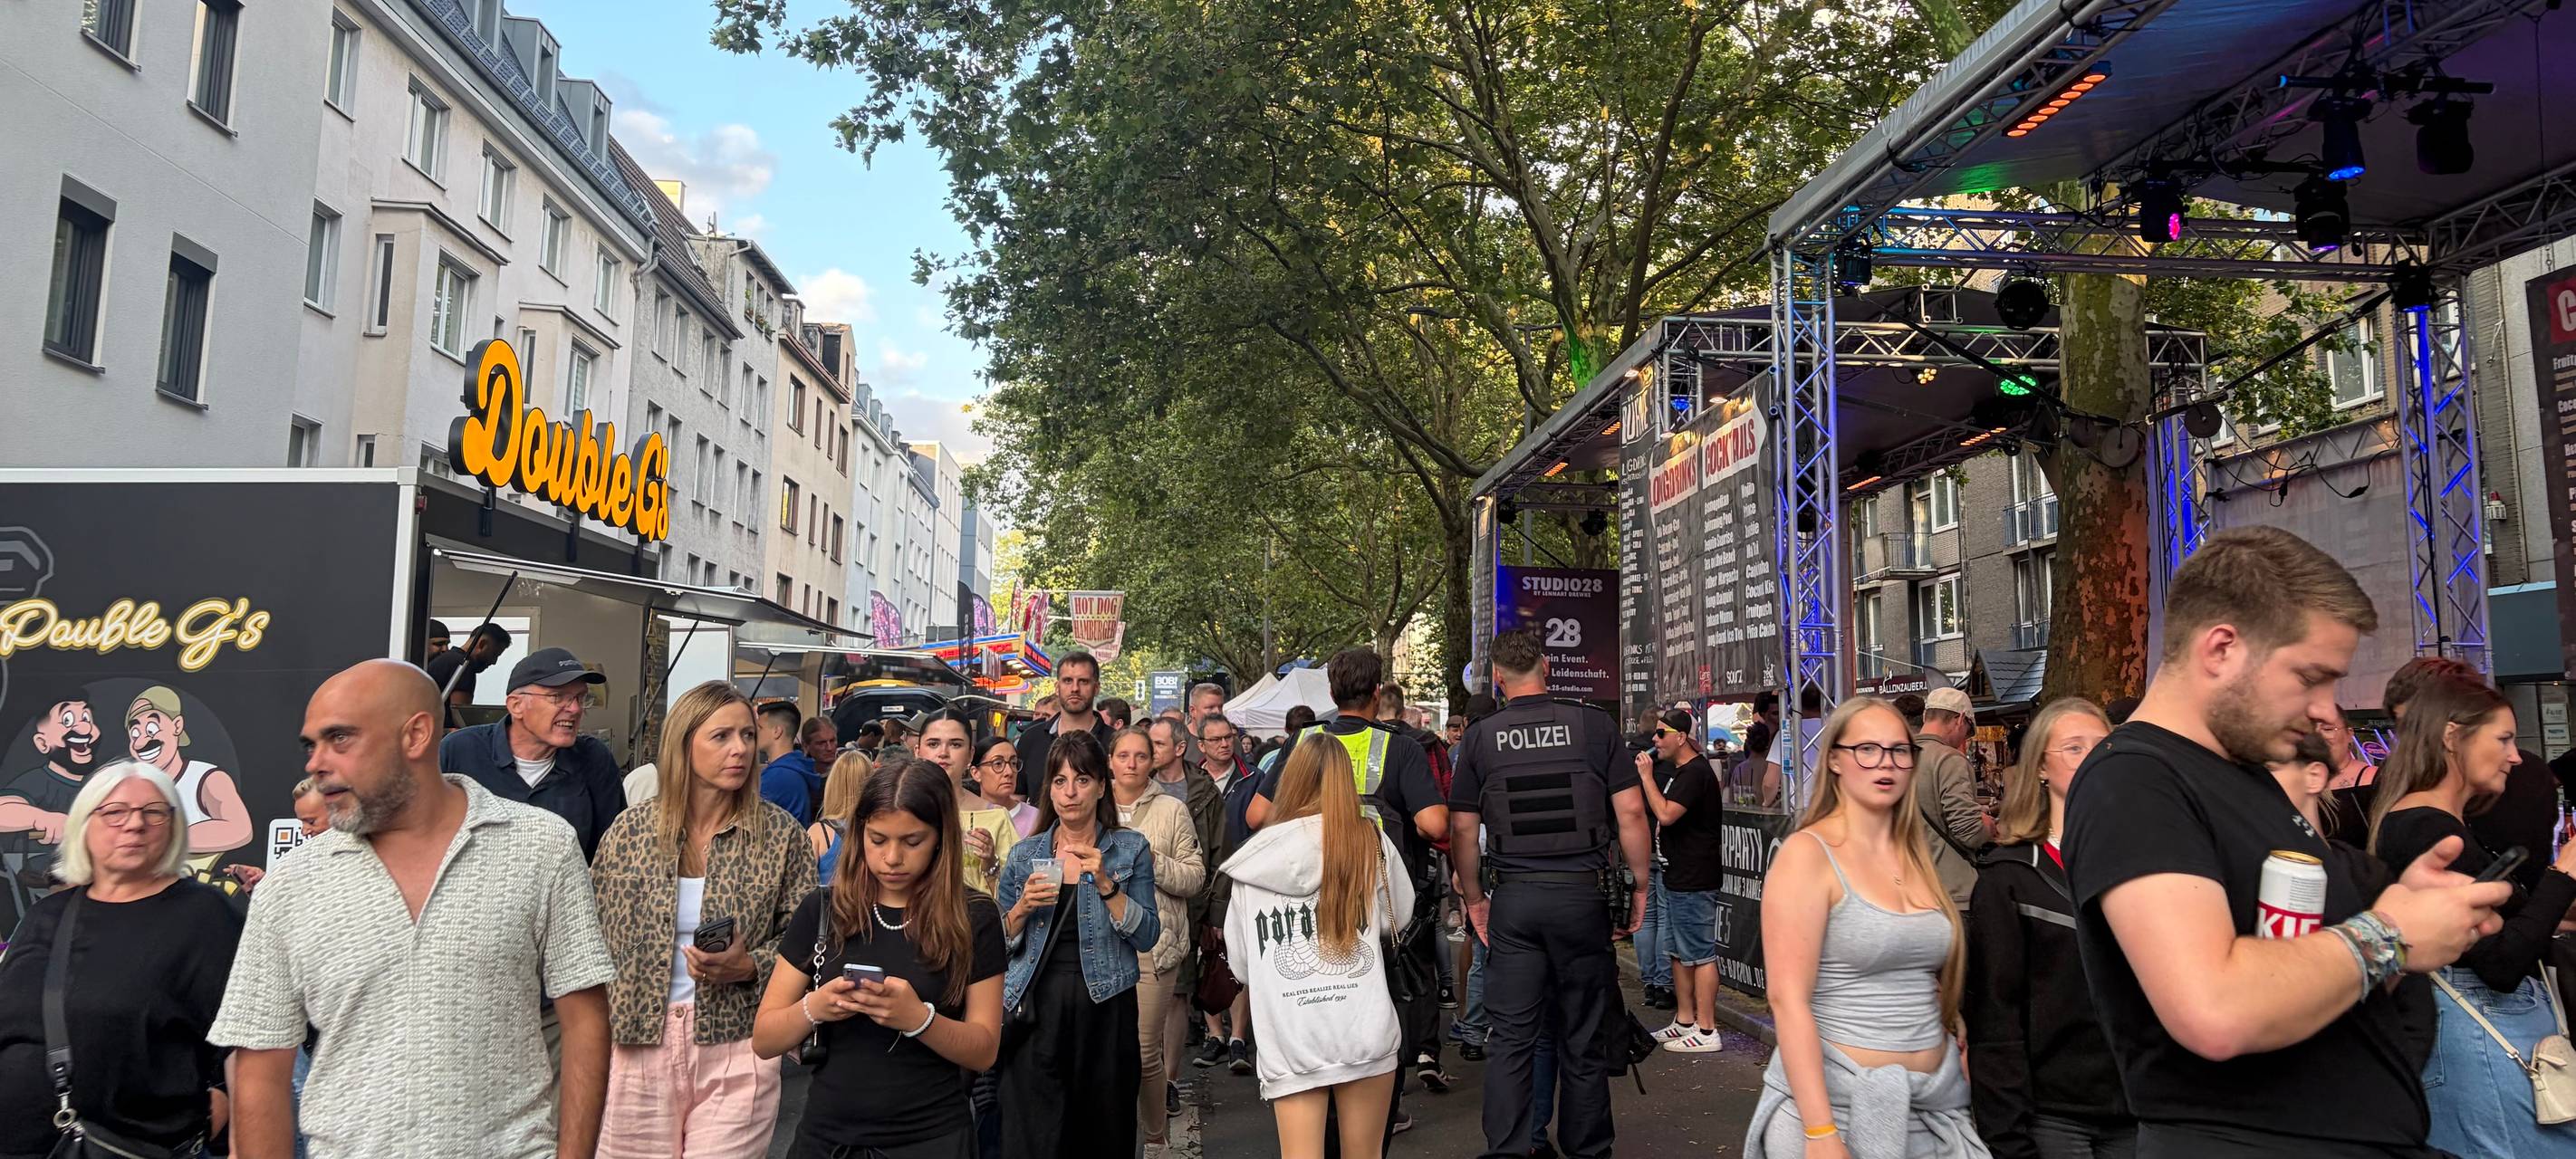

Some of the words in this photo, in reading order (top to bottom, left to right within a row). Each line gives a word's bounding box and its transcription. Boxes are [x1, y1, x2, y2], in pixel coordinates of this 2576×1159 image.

[462, 339, 634, 528] Double
[636, 431, 669, 543] G's
[1704, 417, 1756, 479] COCKTAILS
[1522, 576, 1603, 593] STUDIO28
[1073, 597, 1094, 615] HOT
[1097, 598, 1118, 616] DOG
[0, 598, 171, 659] Double
[172, 598, 271, 673] G's
[1073, 619, 1118, 641] HAMBURGER
[1544, 618, 1581, 647] 28
[1542, 653, 1559, 663] ein
[1562, 654, 1589, 665] Event.
[1552, 667, 1610, 679] Leidenschaft.
[1495, 725, 1572, 752] POLIZEI
[1296, 992, 1335, 1007] Established
[1309, 985, 1332, 994] REALIZE
